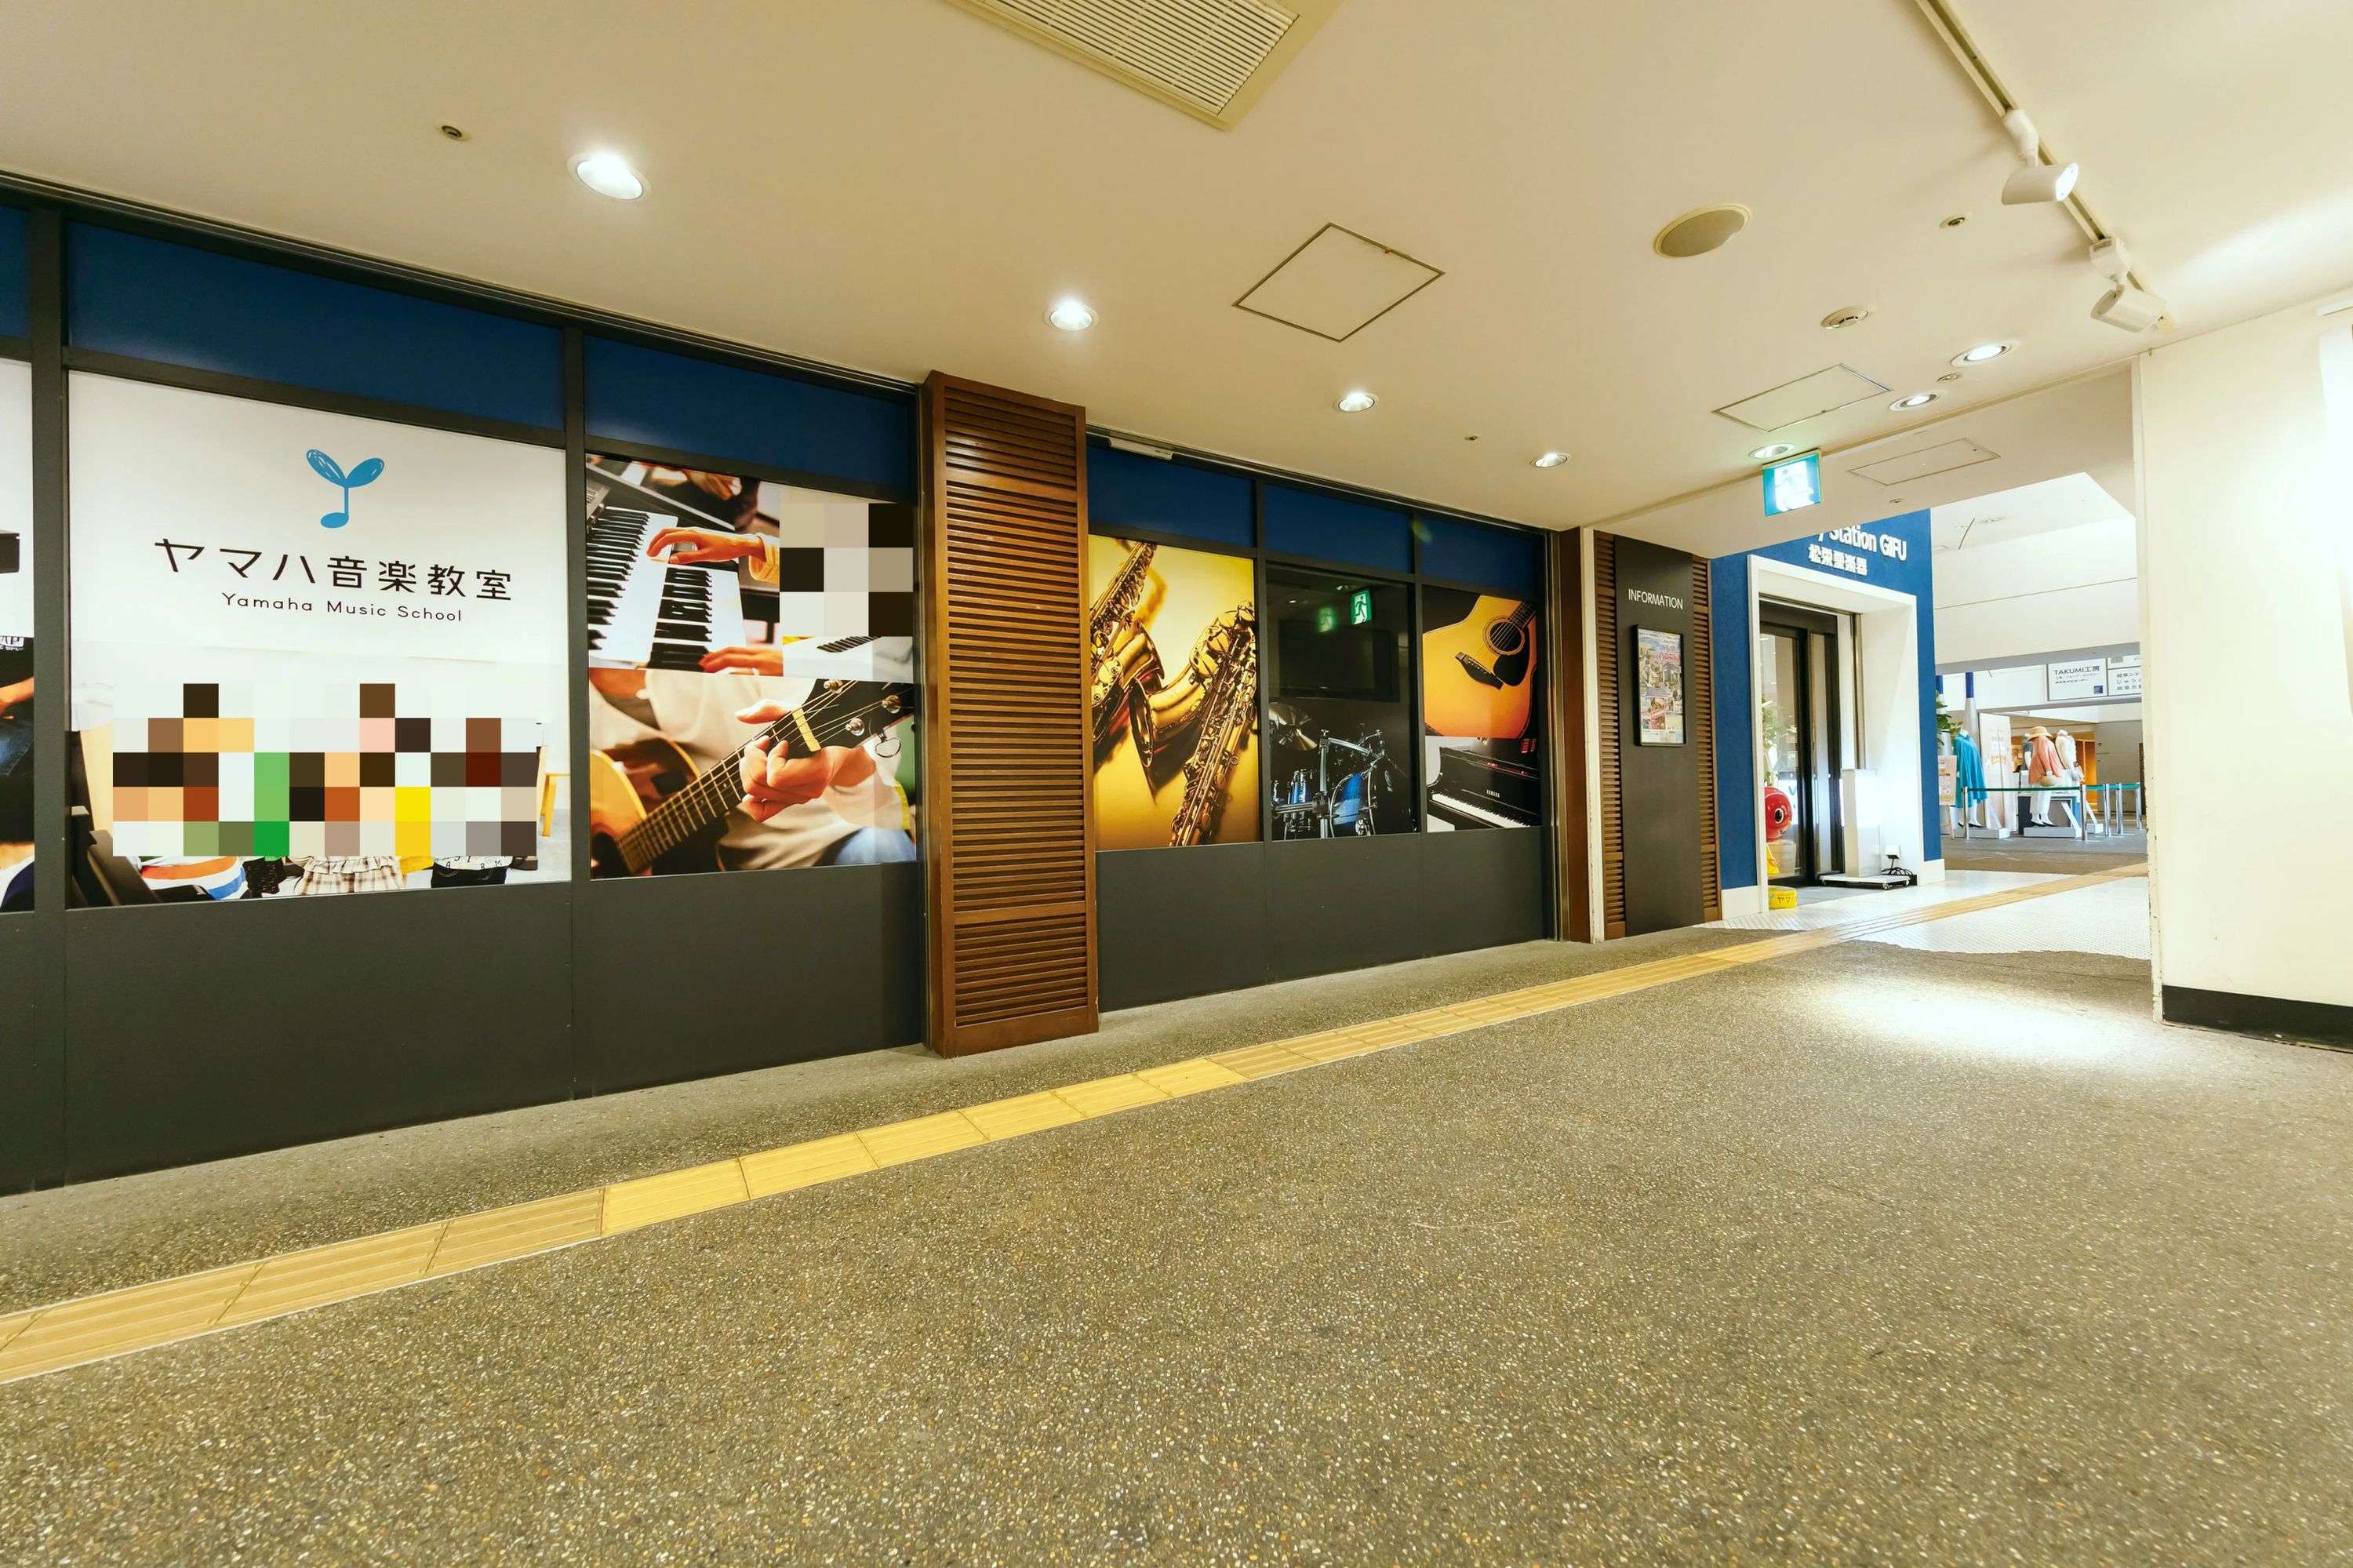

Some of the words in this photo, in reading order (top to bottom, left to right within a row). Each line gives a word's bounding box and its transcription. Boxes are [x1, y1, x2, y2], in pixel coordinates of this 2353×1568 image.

[1879, 534, 1907, 562] GIFU
[155, 538, 511, 601] ヤマハ音楽教室
[221, 592, 312, 611] Yamaha
[327, 600, 387, 617] Music
[398, 606, 461, 622] School
[1628, 588, 1683, 609] INFORMATION
